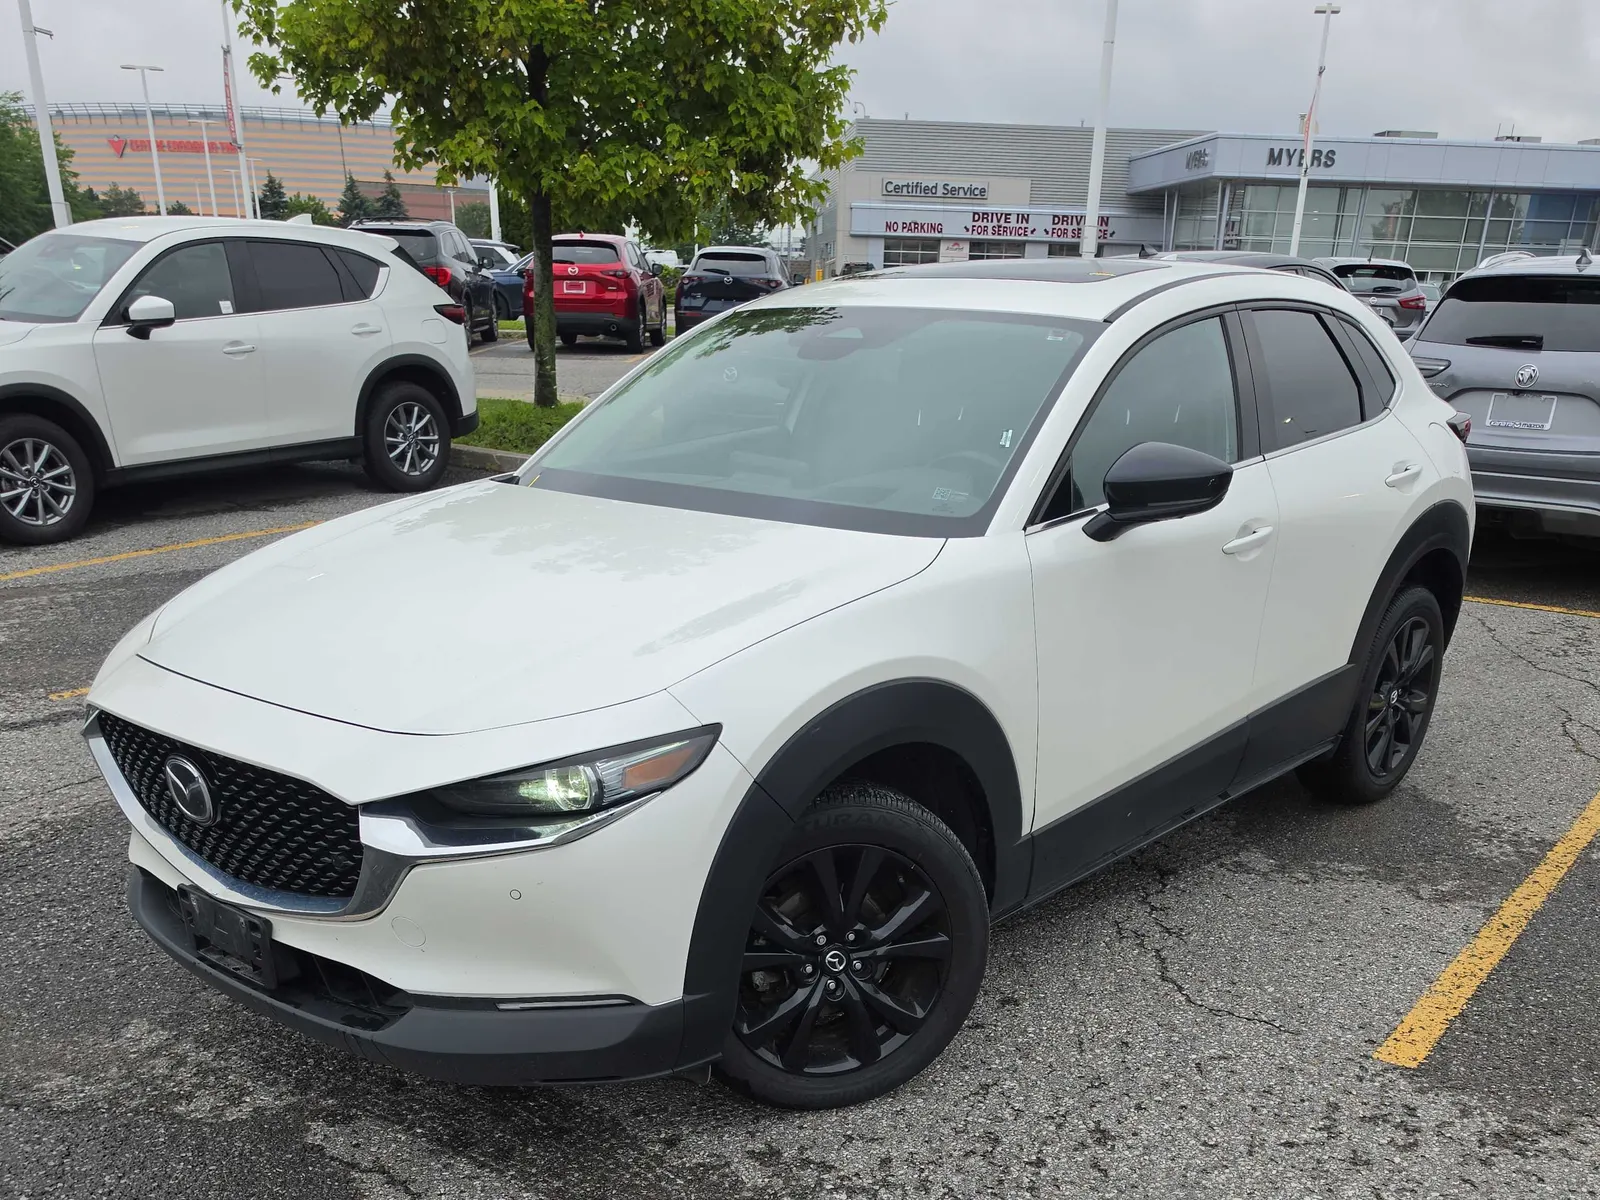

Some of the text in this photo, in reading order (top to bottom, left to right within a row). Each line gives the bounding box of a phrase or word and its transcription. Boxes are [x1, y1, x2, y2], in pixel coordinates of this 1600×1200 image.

[885, 181, 987, 197] Certified Service
[972, 211, 1030, 224] DRIVE IN
[1052, 214, 1086, 226] DRIV
[885, 221, 943, 234] NO PARKING
[971, 224, 1029, 237] FOR SERVICE
[1051, 227, 1069, 238] FOR
